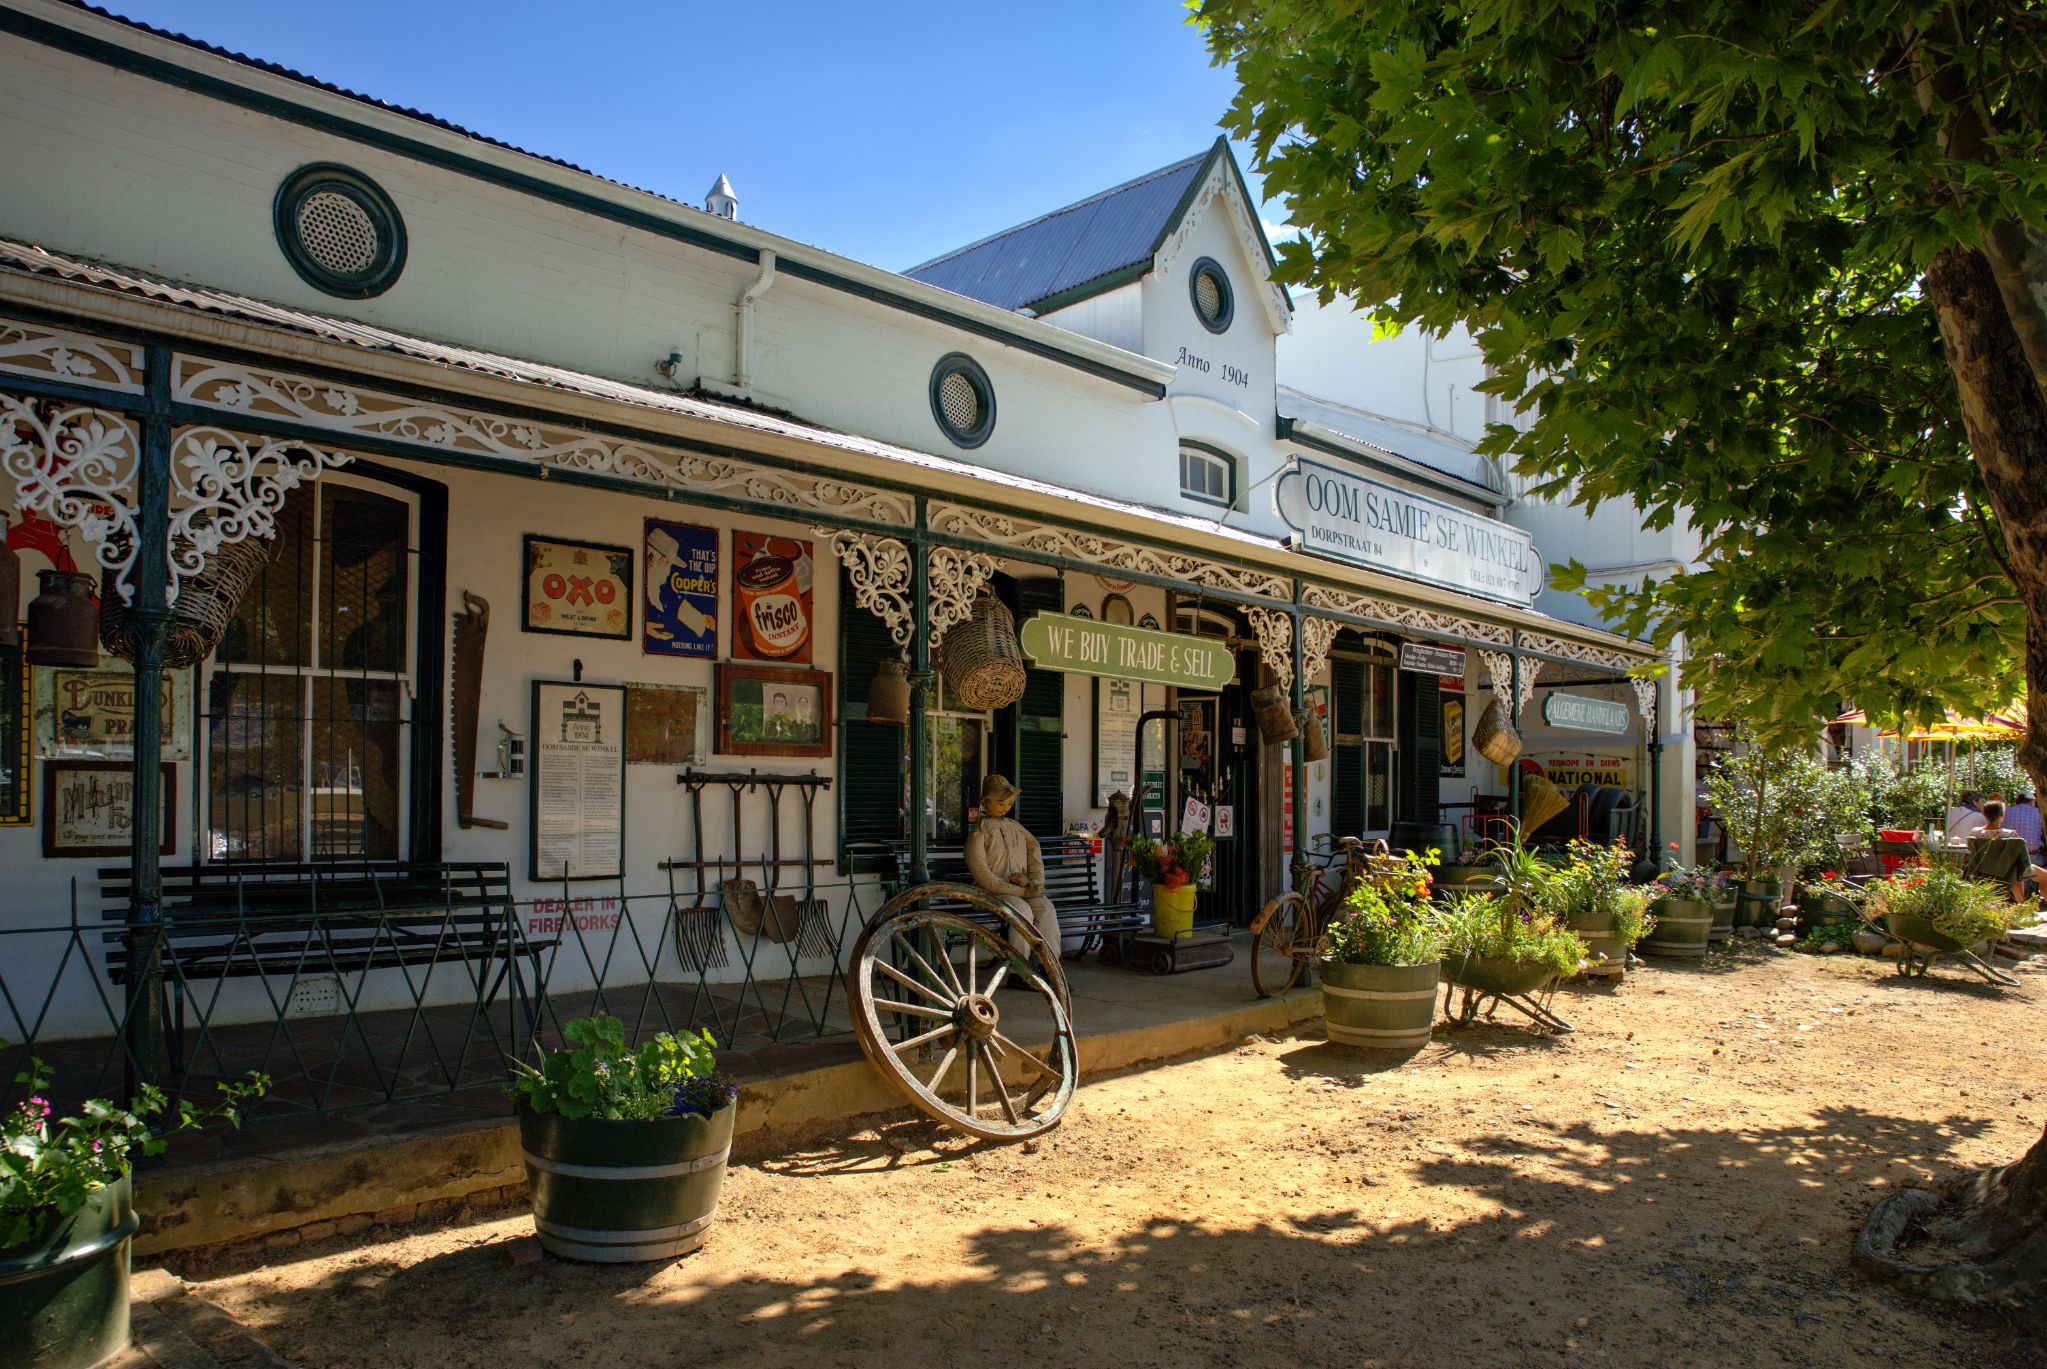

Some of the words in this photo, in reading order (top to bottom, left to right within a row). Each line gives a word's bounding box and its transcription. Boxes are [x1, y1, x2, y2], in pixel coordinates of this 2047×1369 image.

[1174, 346, 1210, 373] Anno
[1221, 364, 1249, 389] 1904
[1305, 473, 1361, 523] OOM
[1366, 492, 1431, 544] SAMIE
[1436, 514, 1459, 552] SE
[1462, 523, 1528, 573] WINKEL
[1311, 525, 1373, 554] DORPSTRAAT
[1373, 543, 1382, 557] 84
[691, 548, 716, 561] THAT'S
[688, 560, 703, 573] THE
[704, 562, 716, 574] DIP
[543, 573, 616, 607] OXO
[670, 571, 716, 594] COOPER'S
[755, 600, 798, 632] frisco
[768, 622, 799, 640] INSTANT
[1047, 625, 1074, 659] WE
[1080, 631, 1111, 664] BUY
[1117, 636, 1166, 672] TRADE
[1170, 645, 1181, 673] &
[1183, 647, 1215, 678] SELL
[1552, 701, 1587, 722] ALGEMENE
[1587, 705, 1626, 727] HANDELAARS
[572, 723, 590, 731] Anno
[574, 731, 589, 740] 1904
[559, 744, 581, 752] SAMIE
[1548, 759, 1579, 767] VERKOPE
[1548, 771, 1621, 785] NATIONAL
[1069, 822, 1089, 832] AGFA
[601, 895, 616, 910] IN
[528, 914, 620, 934] FIREWORKS
